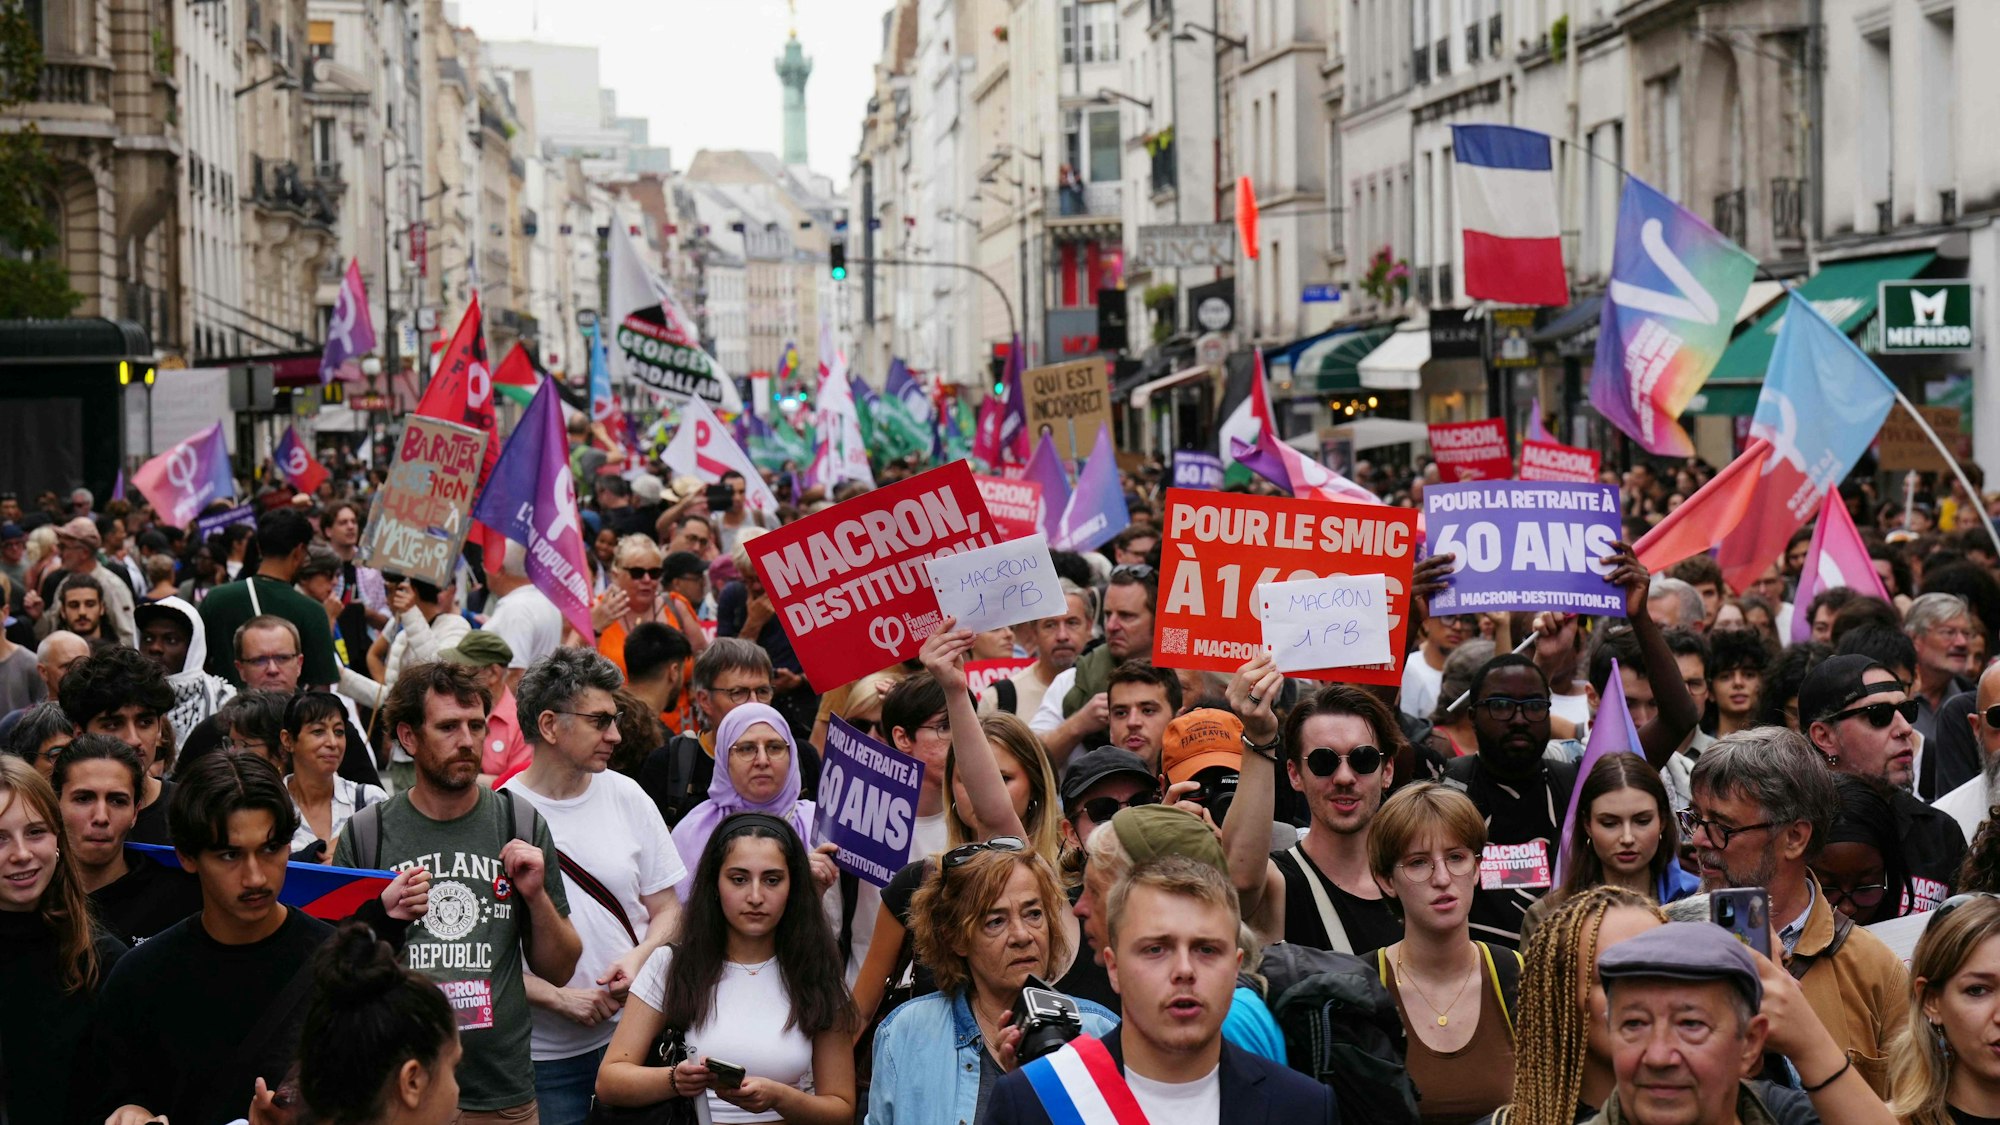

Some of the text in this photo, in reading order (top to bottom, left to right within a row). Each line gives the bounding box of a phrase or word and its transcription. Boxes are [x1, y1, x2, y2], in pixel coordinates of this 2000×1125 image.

[1142, 240, 1231, 264] RINCK
[1886, 325, 1971, 347] MEPHISTO
[619, 329, 709, 373] GEORGES
[1034, 366, 1093, 395] QUI EST
[1523, 444, 1595, 476] MACRON,
[431, 474, 469, 502] NON
[1429, 488, 1616, 514] POUR LA RETRAITE À
[760, 484, 982, 599] MACRON,
[1170, 503, 1410, 559] POUR LE SMIC
[1433, 521, 1619, 576] 60 ANS
[960, 553, 1038, 593] MACRON
[1002, 580, 1043, 611] PB
[1288, 588, 1372, 613] MACRON
[1460, 590, 1621, 610] MACRON-DESTITUTION.FR
[906, 610, 941, 633] FRANCE
[1323, 620, 1360, 645] PB
[827, 723, 918, 789] POUR LA RETRAITE À
[818, 758, 912, 852] 60 ANS
[1480, 858, 1542, 870] DESTITUTION
[1482, 842, 1546, 860] MACRON,
[430, 888, 471, 906] AUTHENTIC
[429, 914, 472, 934] COLLECTION
[494, 903, 512, 920] EDT
[409, 942, 492, 970] REPUBLIC
